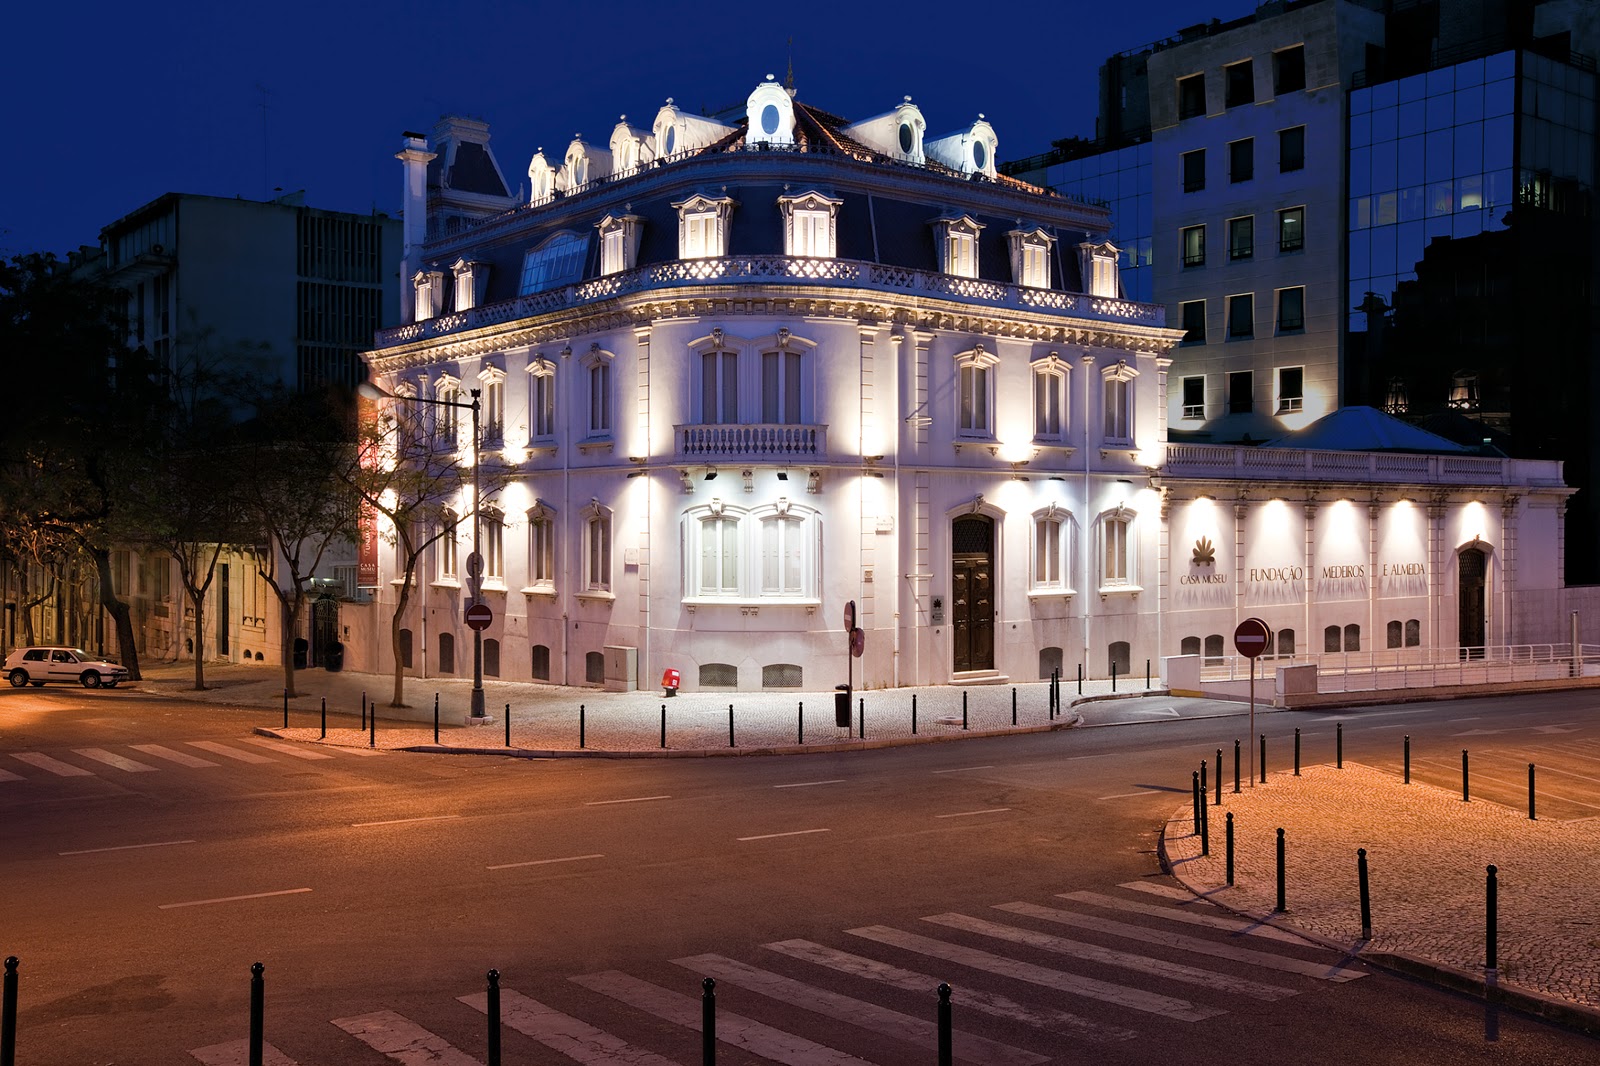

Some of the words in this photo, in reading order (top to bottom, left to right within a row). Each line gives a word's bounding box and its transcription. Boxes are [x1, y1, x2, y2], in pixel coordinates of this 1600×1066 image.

[1180, 575, 1200, 585] CASA
[1202, 574, 1228, 584] MUSEU
[1250, 565, 1303, 584] FUNDAÇÃO
[1322, 565, 1365, 579] MEDEIROS
[1383, 564, 1388, 577] E
[1390, 563, 1425, 576] ALMEIDA
